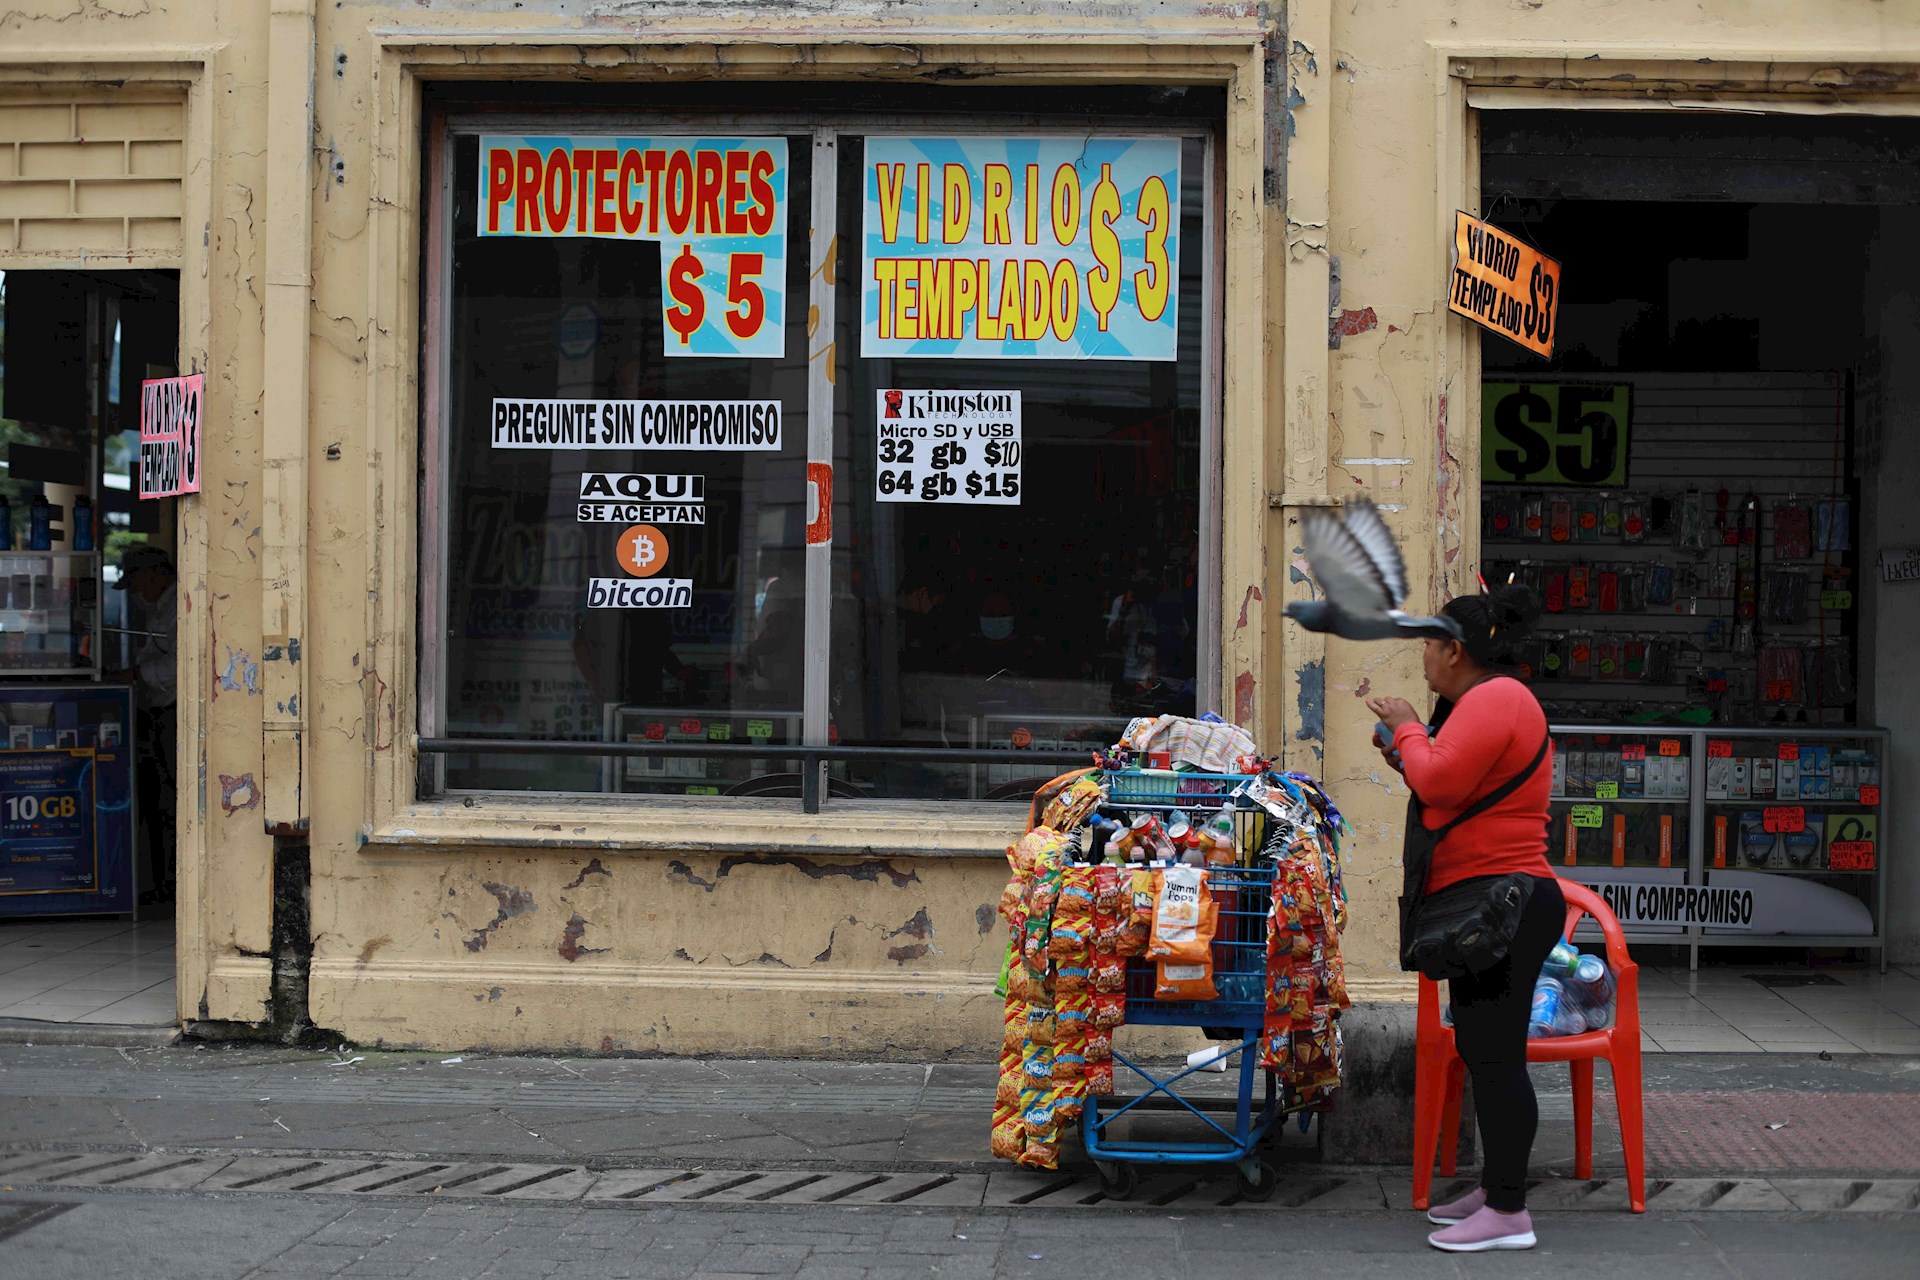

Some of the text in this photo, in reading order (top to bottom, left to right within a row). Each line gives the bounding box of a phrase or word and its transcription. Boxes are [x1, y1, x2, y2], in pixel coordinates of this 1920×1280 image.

[487, 147, 776, 237] PROTECTORES
[876, 162, 1081, 246] VIDRIO
[1467, 223, 1520, 282] VIDRIO
[874, 258, 1080, 342] TEMPLADO
[1453, 268, 1522, 336] TEMPLADO
[1523, 261, 1554, 345] $3
[908, 390, 1012, 419] Kingston
[927, 411, 1013, 419] TECHNOLOGY
[494, 402, 778, 446] PREGUNTE SIN COMPROMISO
[880, 423, 1014, 440] Micro SD y USB
[1494, 384, 1619, 483] $5
[879, 439, 1020, 470] 32 gb $10
[582, 474, 703, 501] AQUI
[878, 470, 1019, 500] 64 gb $15
[578, 505, 704, 522] SE ACEPTAN
[589, 578, 691, 608] bitcoin
[6, 795, 77, 821] 10 GB
[1166, 880, 1198, 896] Yummi
[1168, 891, 1194, 903] Pops
[1636, 886, 1753, 925] COMPROMISO
